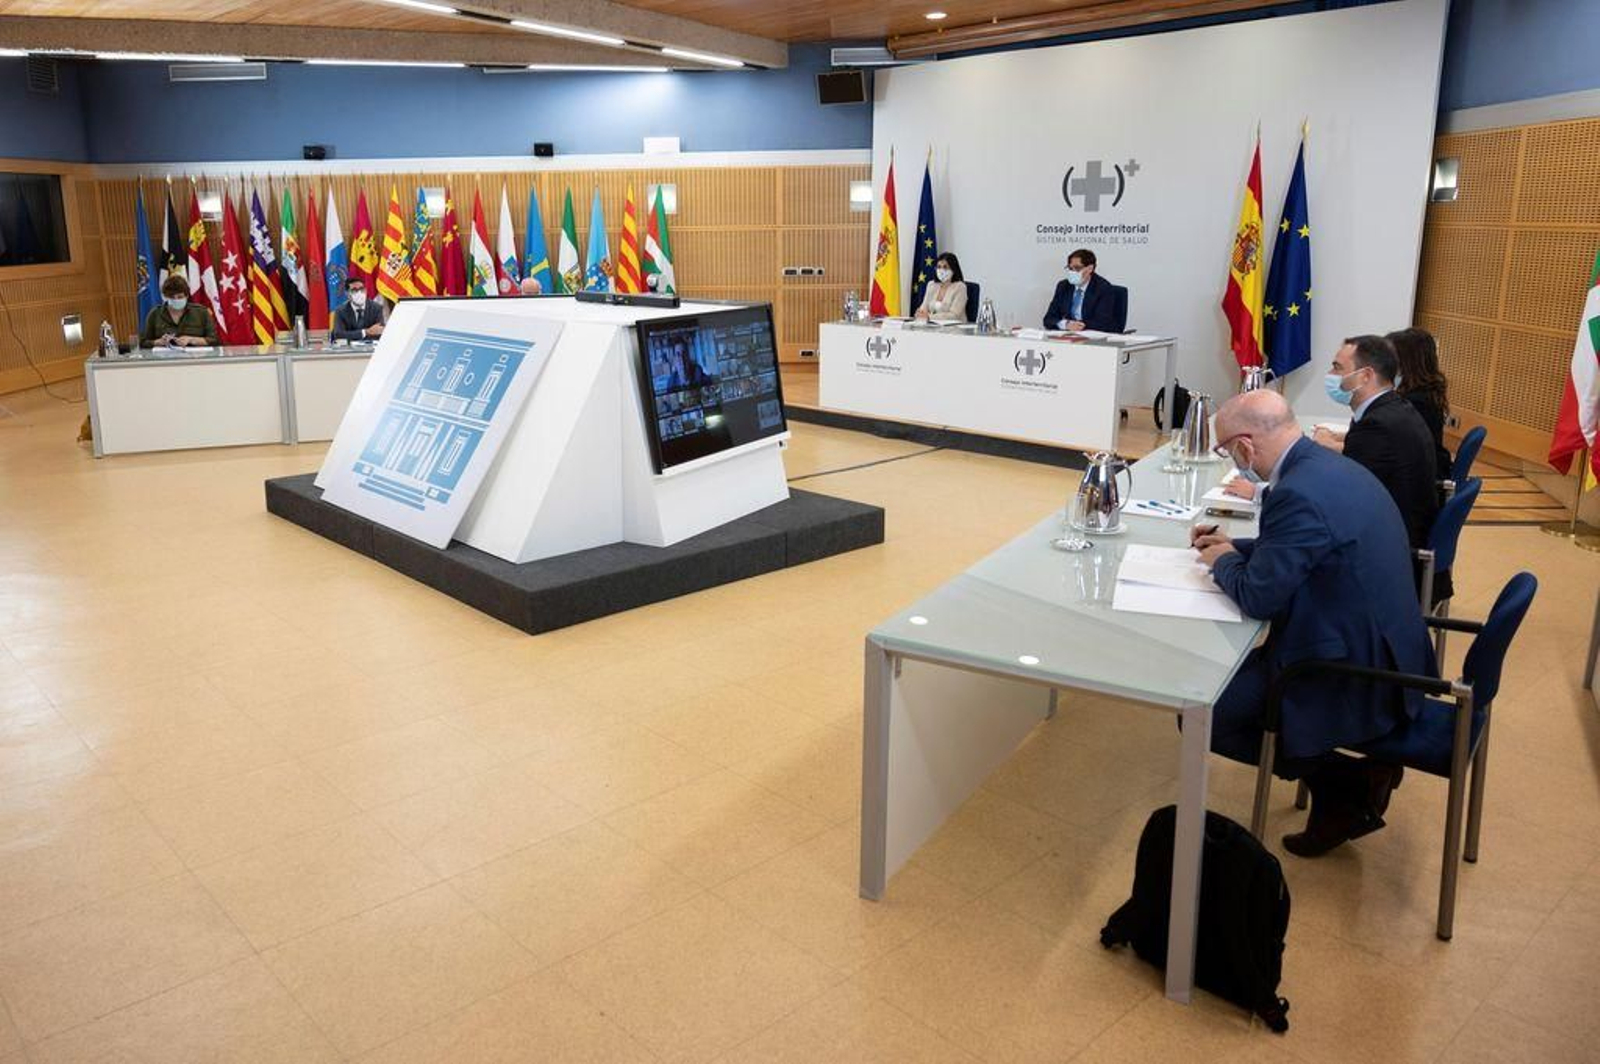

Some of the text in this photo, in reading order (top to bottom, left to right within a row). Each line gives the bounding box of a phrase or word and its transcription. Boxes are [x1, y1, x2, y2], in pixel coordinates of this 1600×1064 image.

[1036, 223, 1149, 235] Consejo Interterritorial
[1036, 236, 1149, 244] SISTEMA NACIONAL DE SALUD
